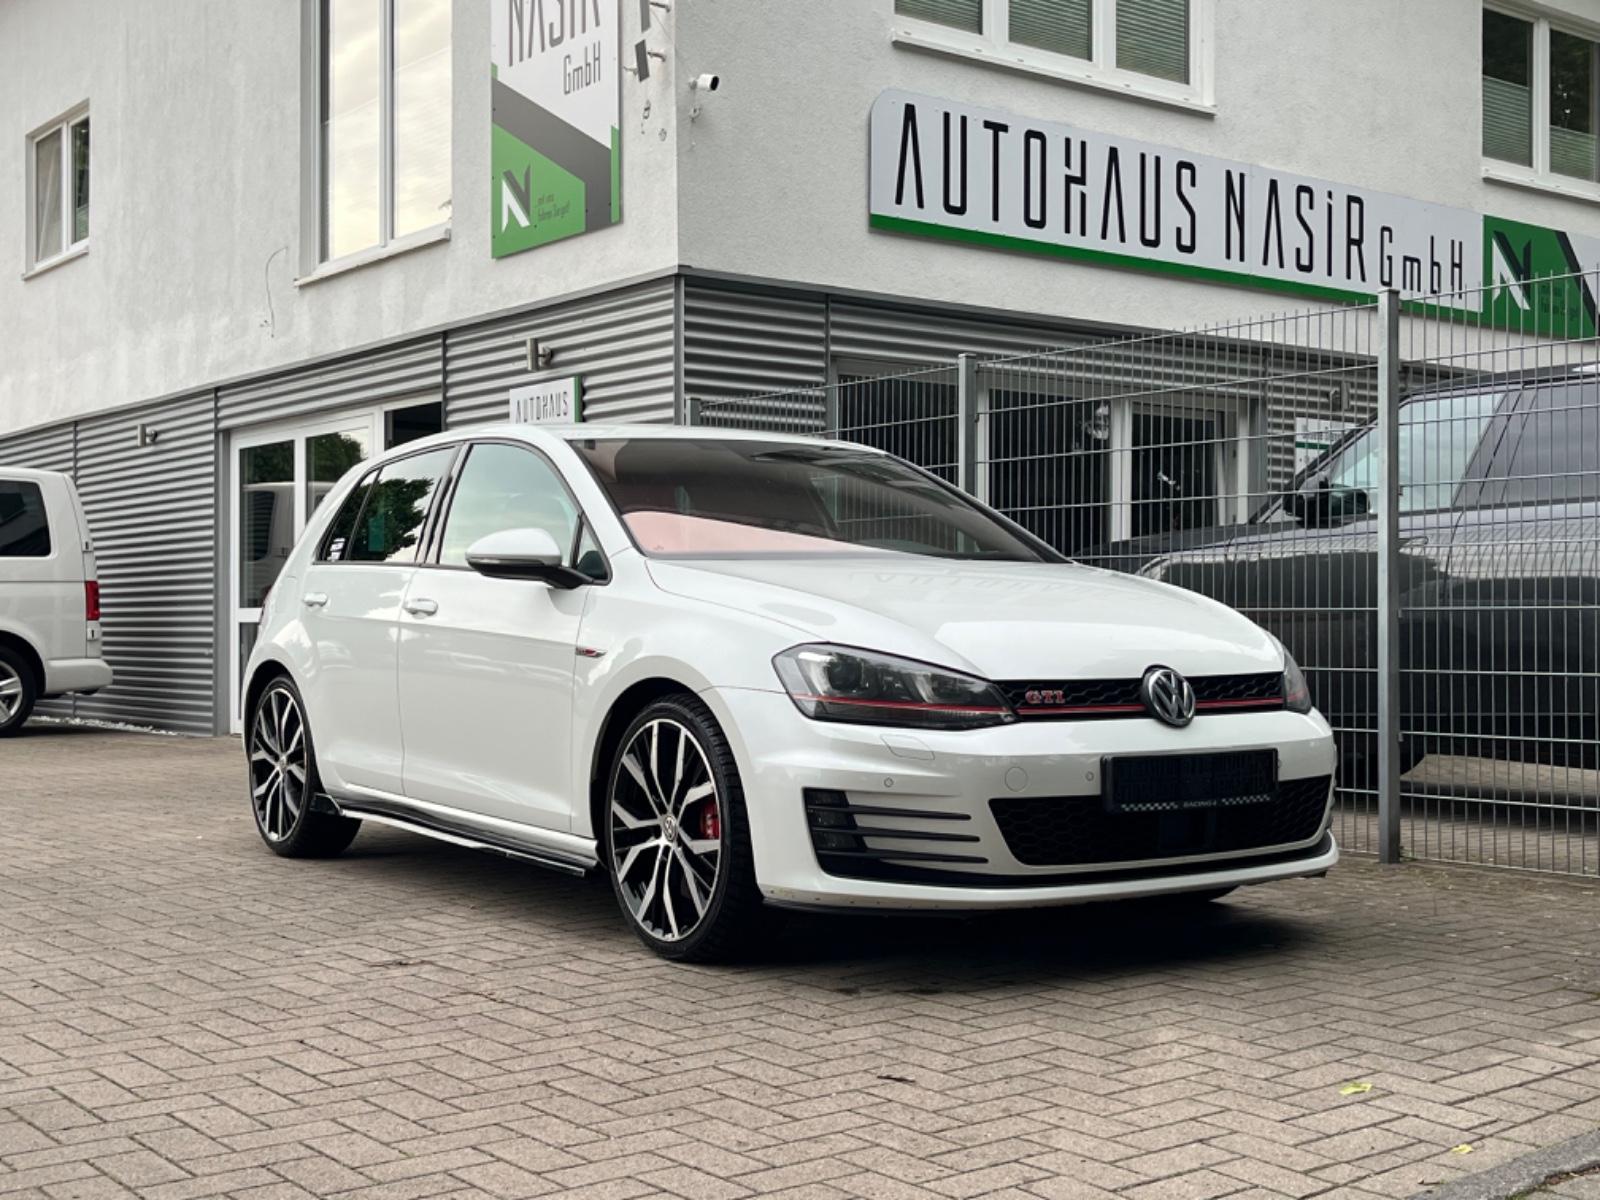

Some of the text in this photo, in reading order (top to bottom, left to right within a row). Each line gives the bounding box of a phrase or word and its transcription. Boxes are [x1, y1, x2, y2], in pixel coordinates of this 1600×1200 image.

[563, 40, 601, 95] GmbH
[895, 102, 1197, 255] AUTOHAUS
[1380, 225, 1463, 300] GmbH
[515, 391, 568, 424] AUTOHAUS
[1025, 689, 1066, 704] GTI
